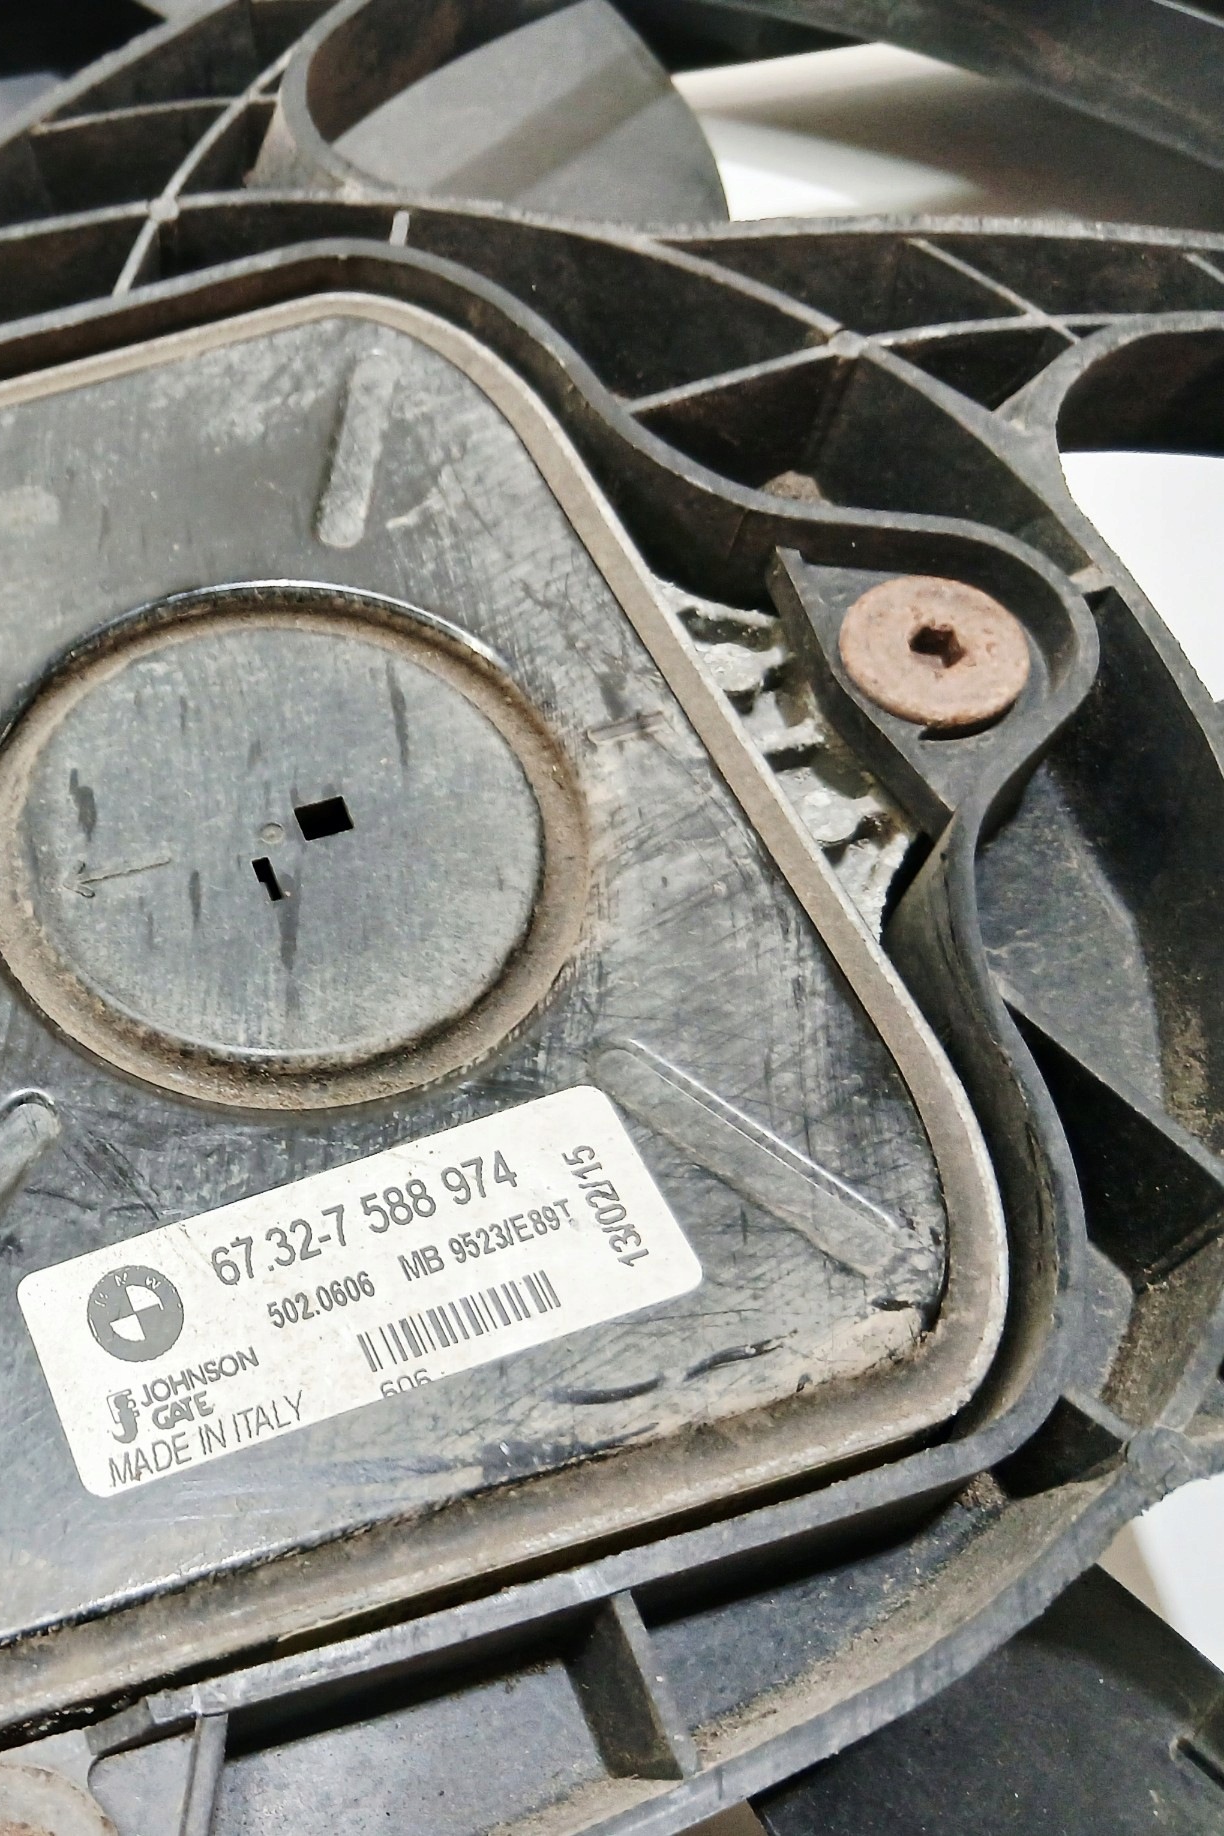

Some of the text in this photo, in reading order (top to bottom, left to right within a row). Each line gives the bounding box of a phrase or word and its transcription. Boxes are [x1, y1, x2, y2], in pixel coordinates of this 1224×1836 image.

[210, 1150, 518, 1286] 67.32-7 588 974
[561, 1145, 650, 1268] 13/02/15
[267, 1271, 375, 1328] 502.0606
[398, 1244, 445, 1281] MB
[141, 1346, 259, 1407] JOHNSON
[152, 1391, 214, 1430] GATE
[109, 1389, 303, 1487] MADE IN ITALY
